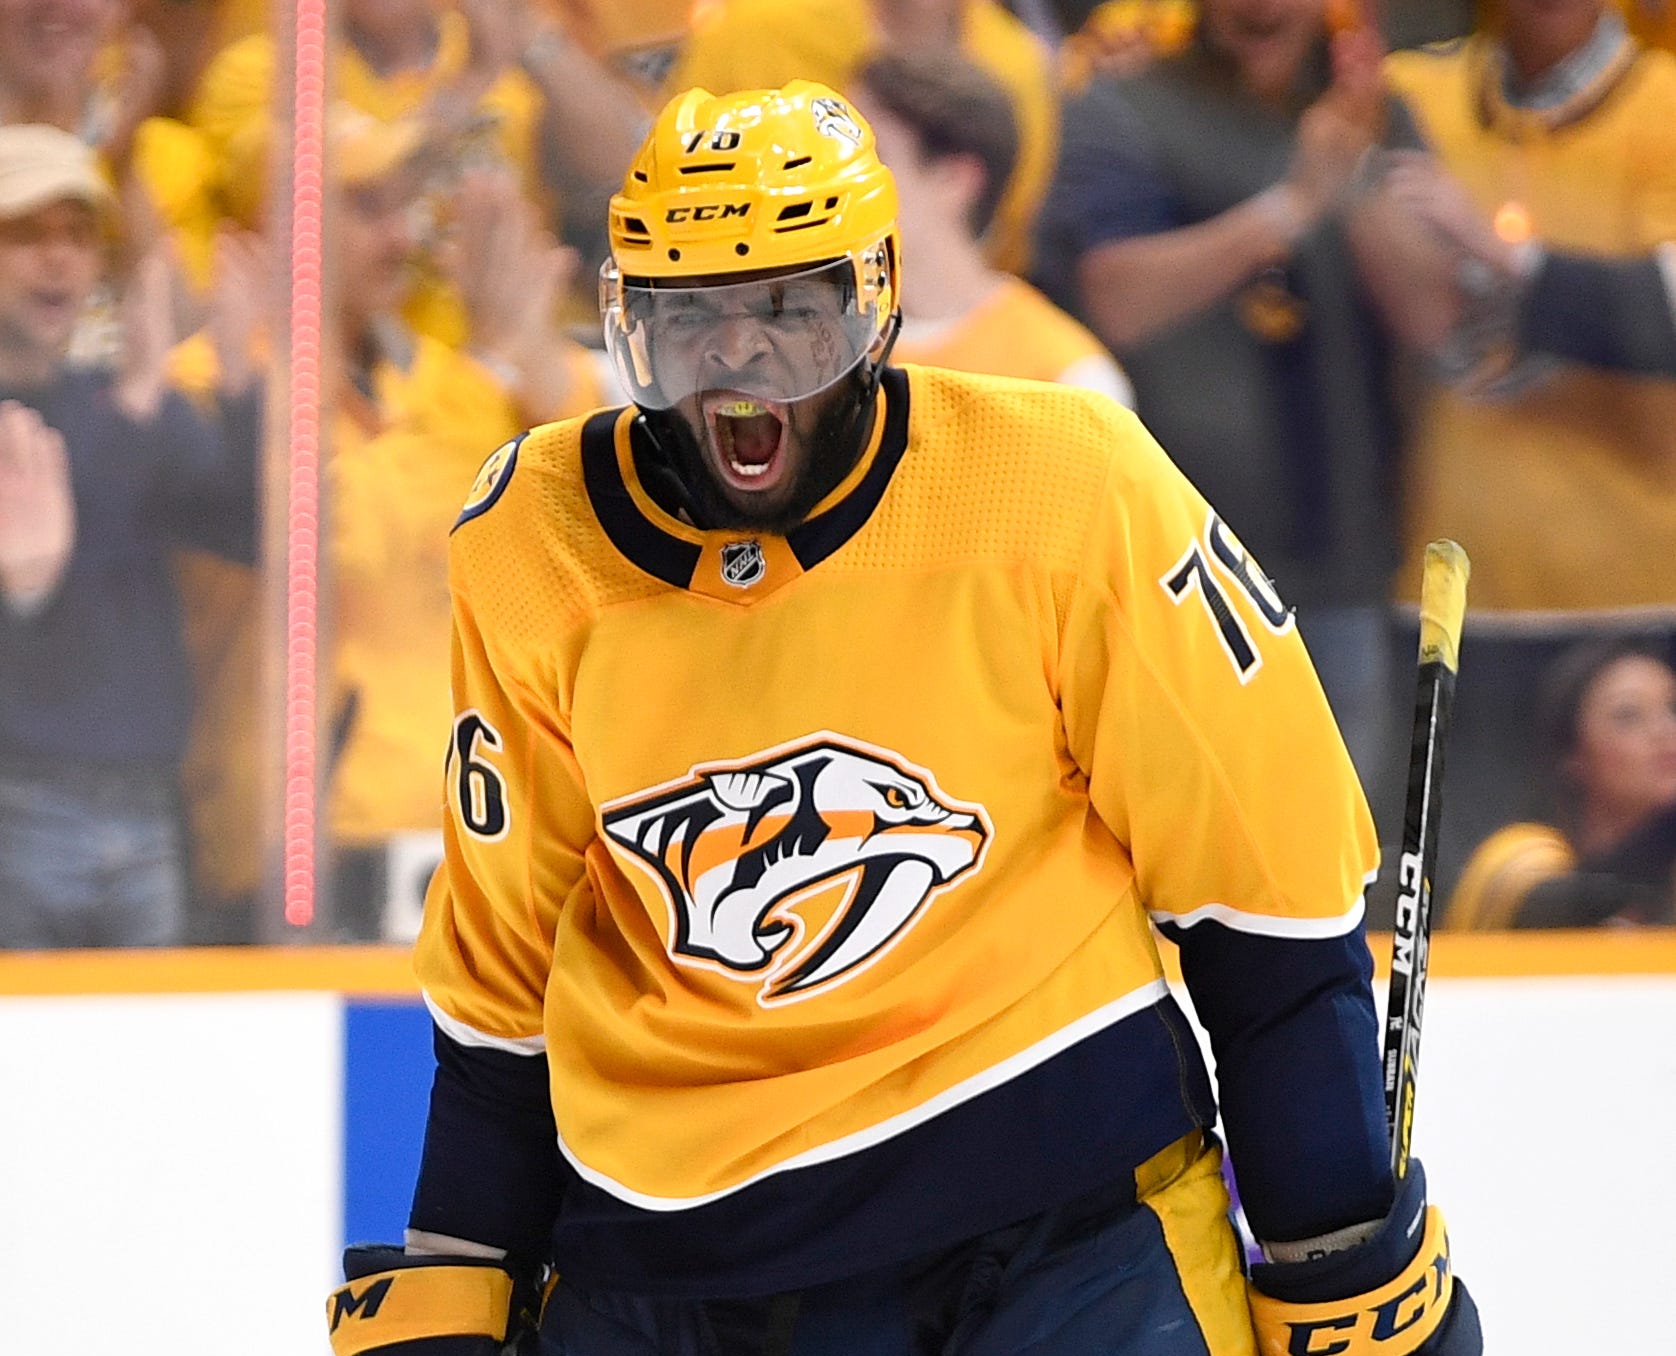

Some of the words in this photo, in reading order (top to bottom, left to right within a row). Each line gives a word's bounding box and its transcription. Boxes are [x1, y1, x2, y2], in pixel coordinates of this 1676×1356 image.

[665, 202, 752, 224] CCM
[443, 707, 511, 844] 6
[1392, 851, 1423, 977] CCM
